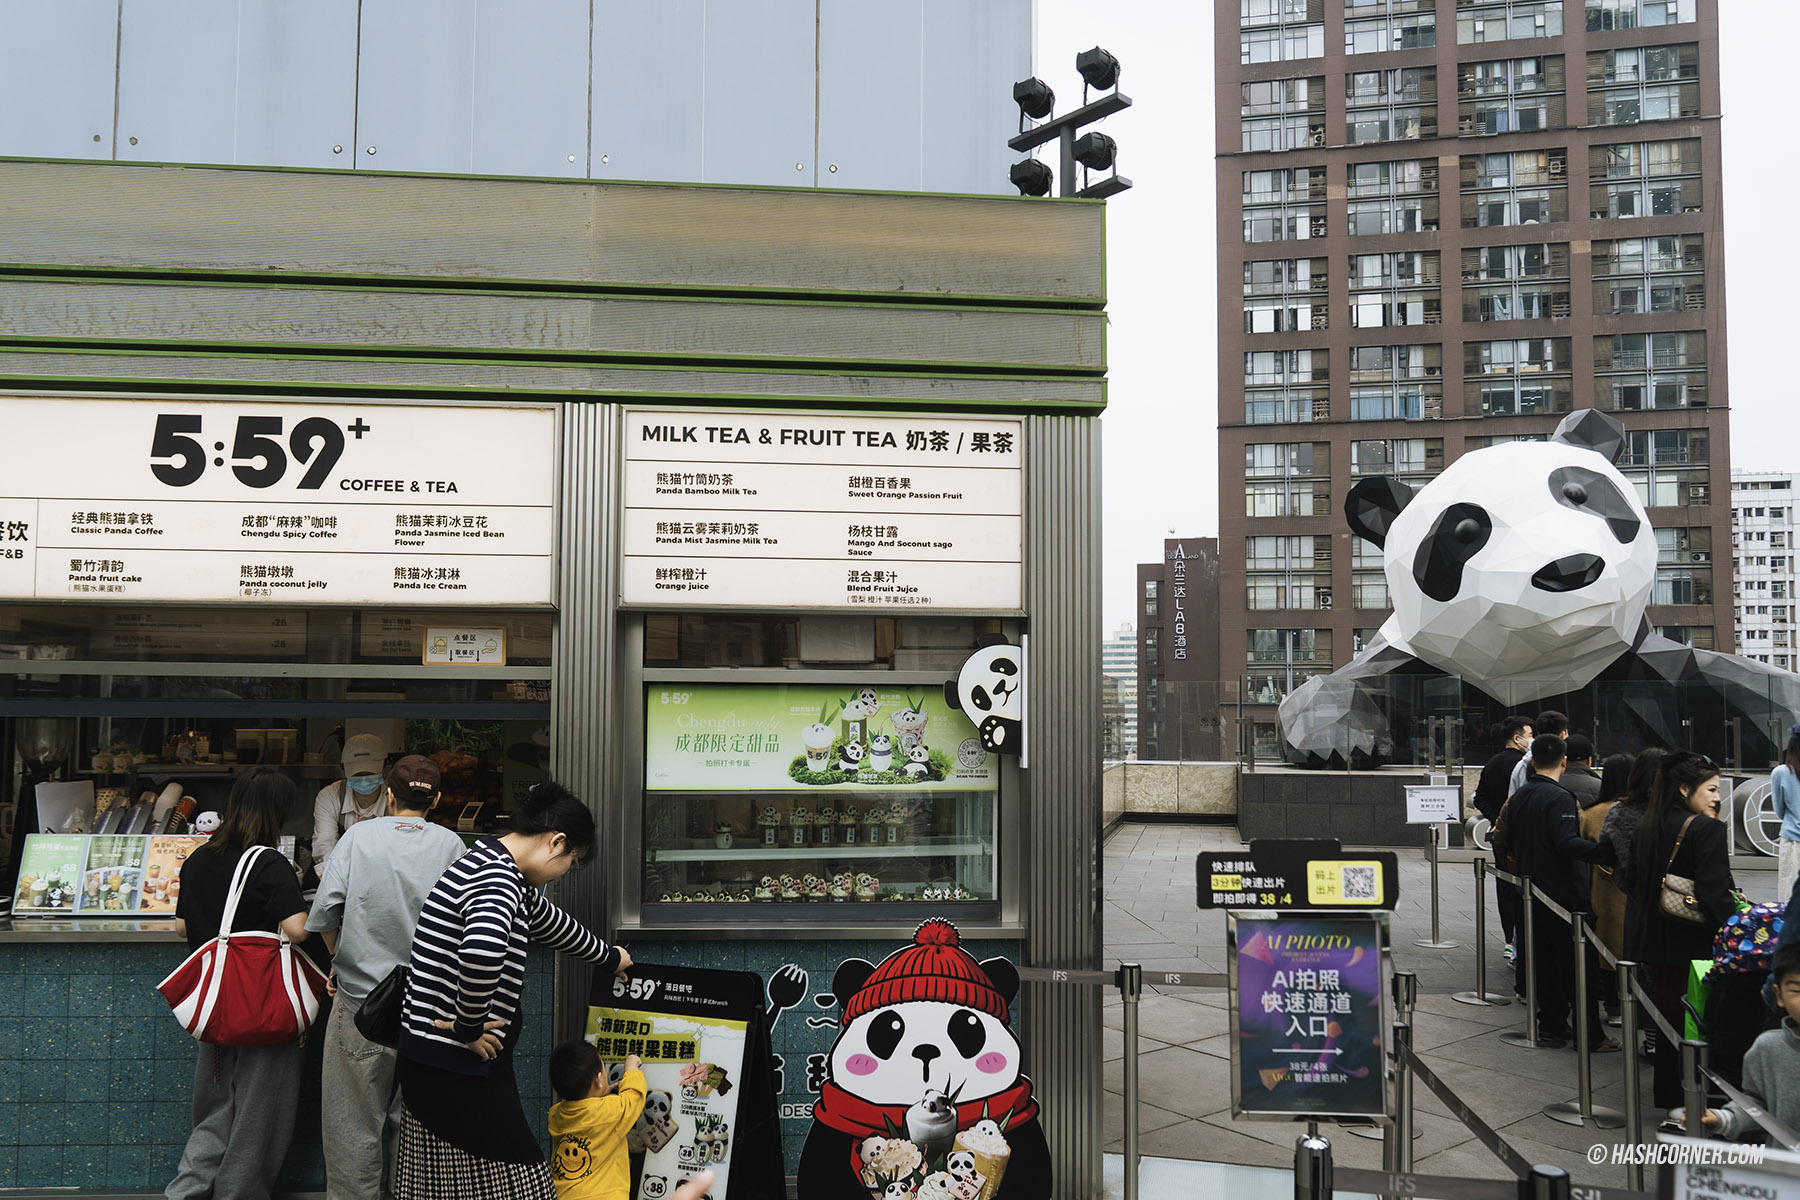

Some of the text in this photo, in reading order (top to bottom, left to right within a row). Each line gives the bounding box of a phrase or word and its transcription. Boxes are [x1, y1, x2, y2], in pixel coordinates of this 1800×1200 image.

[642, 424, 698, 443] MILK
[705, 426, 751, 444] TEA
[758, 428, 773, 445] &
[780, 428, 846, 446] FRUIT
[852, 430, 897, 448] TEA
[905, 429, 950, 452] 奶茶
[970, 431, 1014, 454] 果茶
[656, 472, 734, 486] 熊猫竹筒奶茶
[848, 475, 912, 490] 甜橙百香果
[339, 479, 458, 494] COFFEE & TEA
[655, 487, 683, 495] Panda
[684, 487, 720, 495] Bamboo
[742, 488, 757, 496] Tea
[848, 490, 963, 500] Sweet Orange Passion Fruit
[71, 511, 154, 526] 经典熊猫拿铁
[395, 514, 488, 529] 熊猫茉莉冰豆花
[0, 520, 29, 542] 饮
[70, 527, 163, 536] Classic Panda Coffee
[241, 530, 338, 540] Chengdu Spicy Coffee
[394, 529, 505, 538] Panda Jasmine Iced Bean
[656, 521, 759, 536] 熊猫云雾茉莉奶茶
[847, 525, 899, 539] 杨枝甘露
[394, 539, 425, 547] Flower
[655, 536, 778, 545] Panda Mist Jasmine Milk Tea
[847, 539, 953, 549] Mango And Soconut sago
[69, 558, 125, 573] 蜀竹清韵
[240, 565, 294, 579] 熊猫墩墩
[68, 574, 143, 583] Panda fruit cake
[393, 566, 461, 581] 熊猫冰淇淋
[655, 567, 708, 581] 鲜榨橙汁
[847, 570, 898, 583] 混合果汁
[239, 580, 328, 590] Panda coconut jelly
[393, 582, 468, 591] Panda Ice Cream
[655, 582, 710, 592] Orange juice
[847, 584, 872, 592] Blend
[873, 584, 894, 593] Fruit
[453, 633, 477, 642] 点餐区
[676, 713, 746, 732] Chengdu
[674, 732, 780, 753] 成都限定甜品
[705, 759, 750, 767] 拍照打卡专属
[1211, 860, 1257, 873] 快速排队
[1212, 876, 1286, 890] 3分钟快速出片
[1315, 884, 1337, 896] 出片
[1212, 892, 1258, 906] 即拍即得
[1259, 893, 1276, 906] 38
[1265, 934, 1351, 950] AI PHOTO
[1052, 970, 1068, 981] IFS
[1165, 973, 1181, 985] IFS
[1271, 968, 1340, 991] AI拍照
[1260, 990, 1352, 1014] 快速通道
[1285, 1015, 1329, 1037] 入口
[597, 1037, 696, 1060] 熊猫鲜果蛋糕
[1289, 1061, 1329, 1071] 38元/4张
[566, 1134, 592, 1151] Smile
[1388, 1174, 1417, 1194] IFS
[1686, 1175, 1777, 1200] CHENGDU
